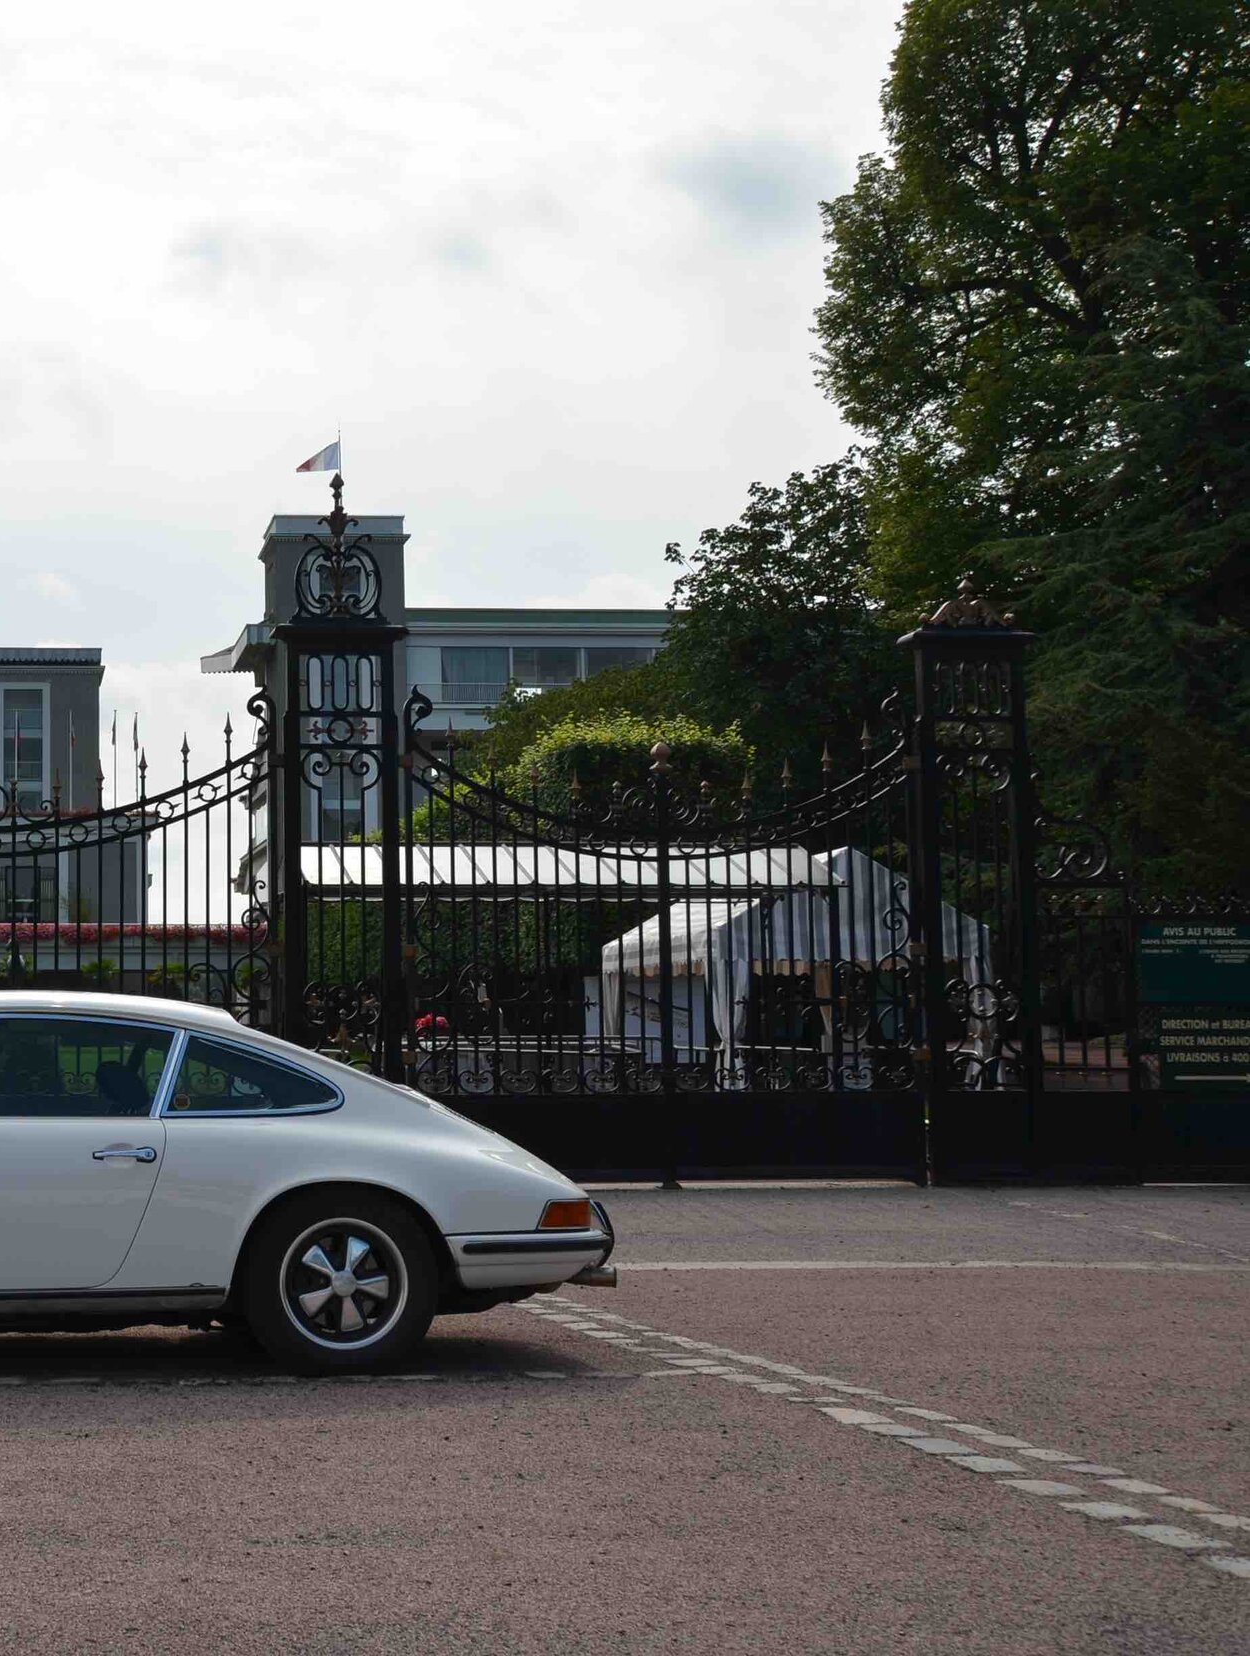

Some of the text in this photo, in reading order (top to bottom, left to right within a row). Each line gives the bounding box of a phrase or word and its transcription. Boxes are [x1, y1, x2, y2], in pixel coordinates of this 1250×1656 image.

[1163, 927, 1236, 936] AVIS AU PUBLIC
[1162, 1019, 1210, 1029] DIRECTION
[1159, 1036, 1195, 1046] SERVICE
[1166, 1053, 1220, 1063] LIVRAISONS
